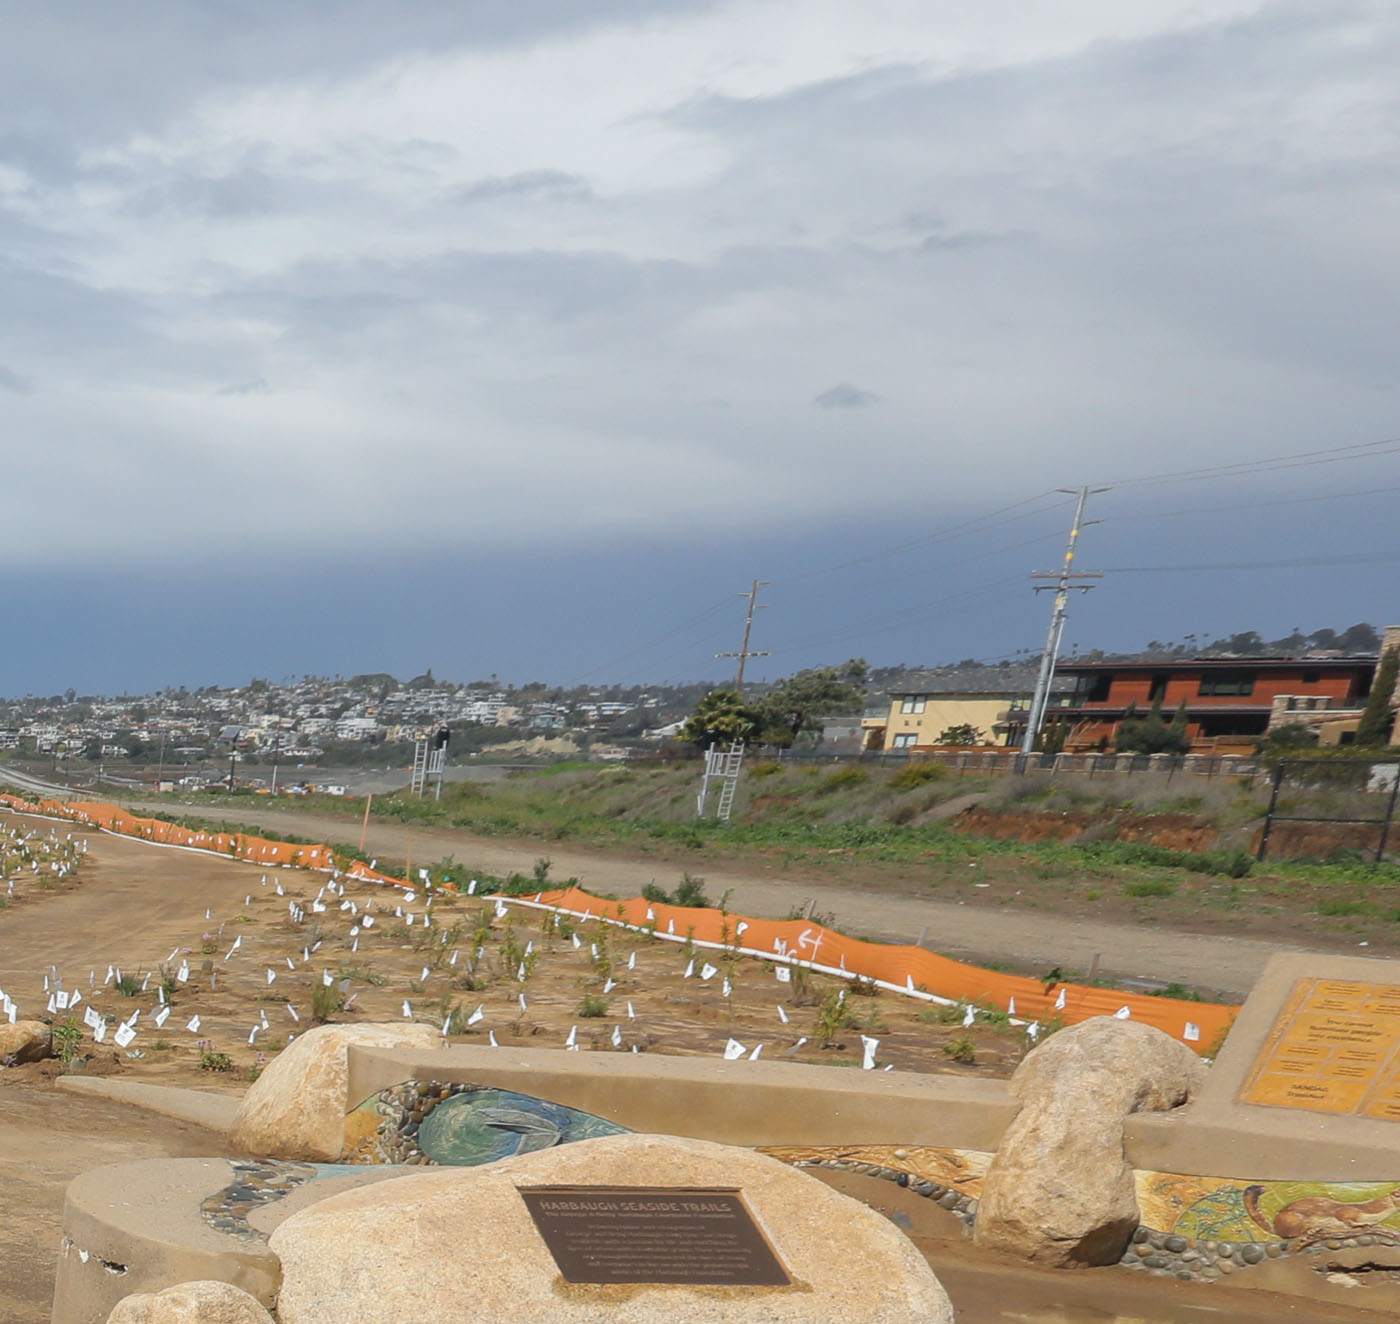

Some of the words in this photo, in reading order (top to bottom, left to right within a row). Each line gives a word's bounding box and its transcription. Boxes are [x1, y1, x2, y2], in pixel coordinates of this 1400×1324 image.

[539, 1201, 619, 1211] HARBAUGH
[620, 1202, 680, 1212] SEASIDE
[680, 1203, 732, 1212] TRAILS
